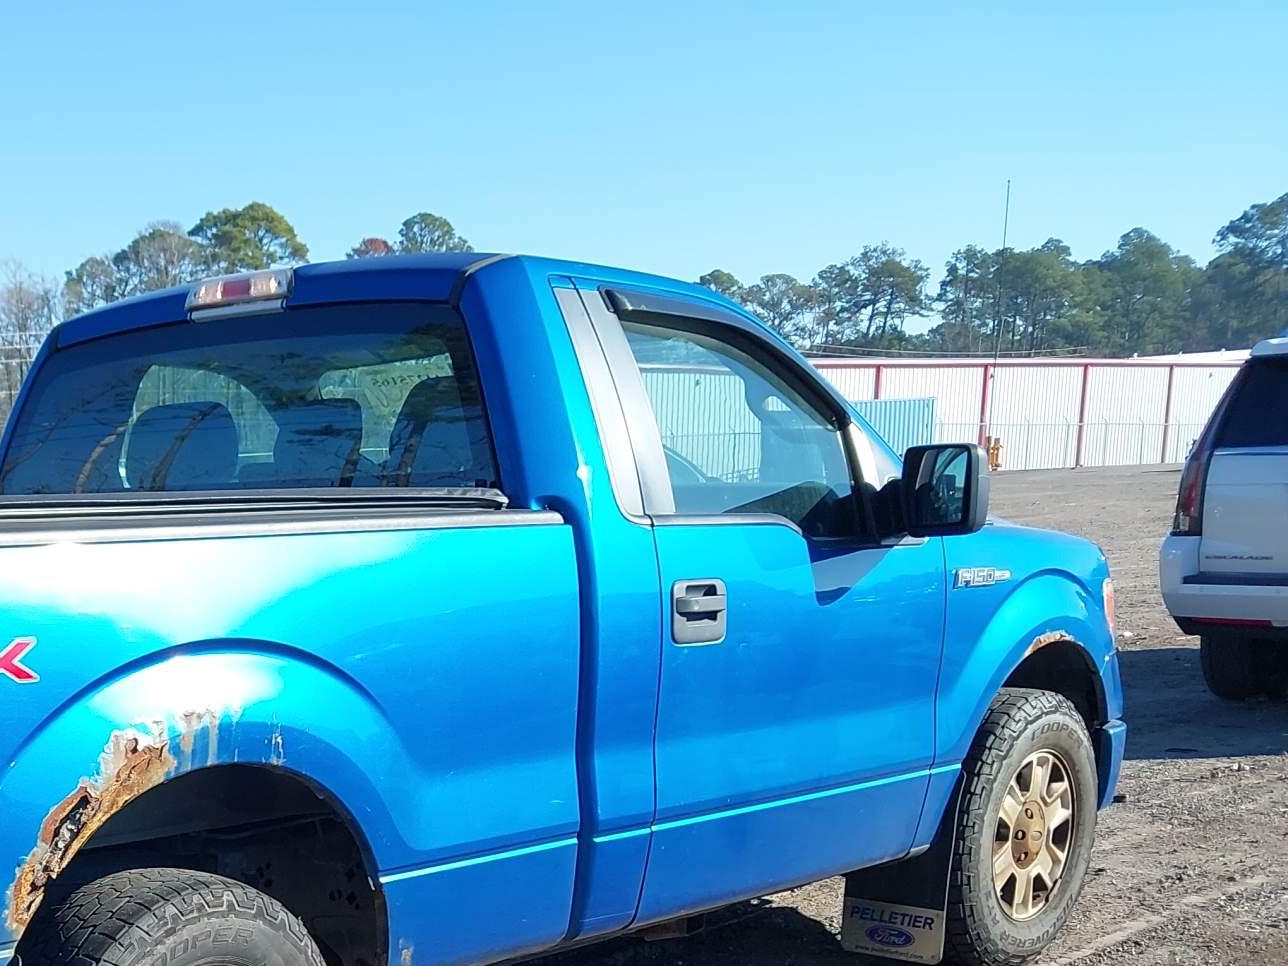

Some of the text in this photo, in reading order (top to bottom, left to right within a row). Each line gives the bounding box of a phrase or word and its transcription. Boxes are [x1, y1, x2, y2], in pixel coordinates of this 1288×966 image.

[1031, 721, 1083, 750] COOPER
[850, 905, 935, 931] PELLETIER
[872, 928, 907, 945] Ford
